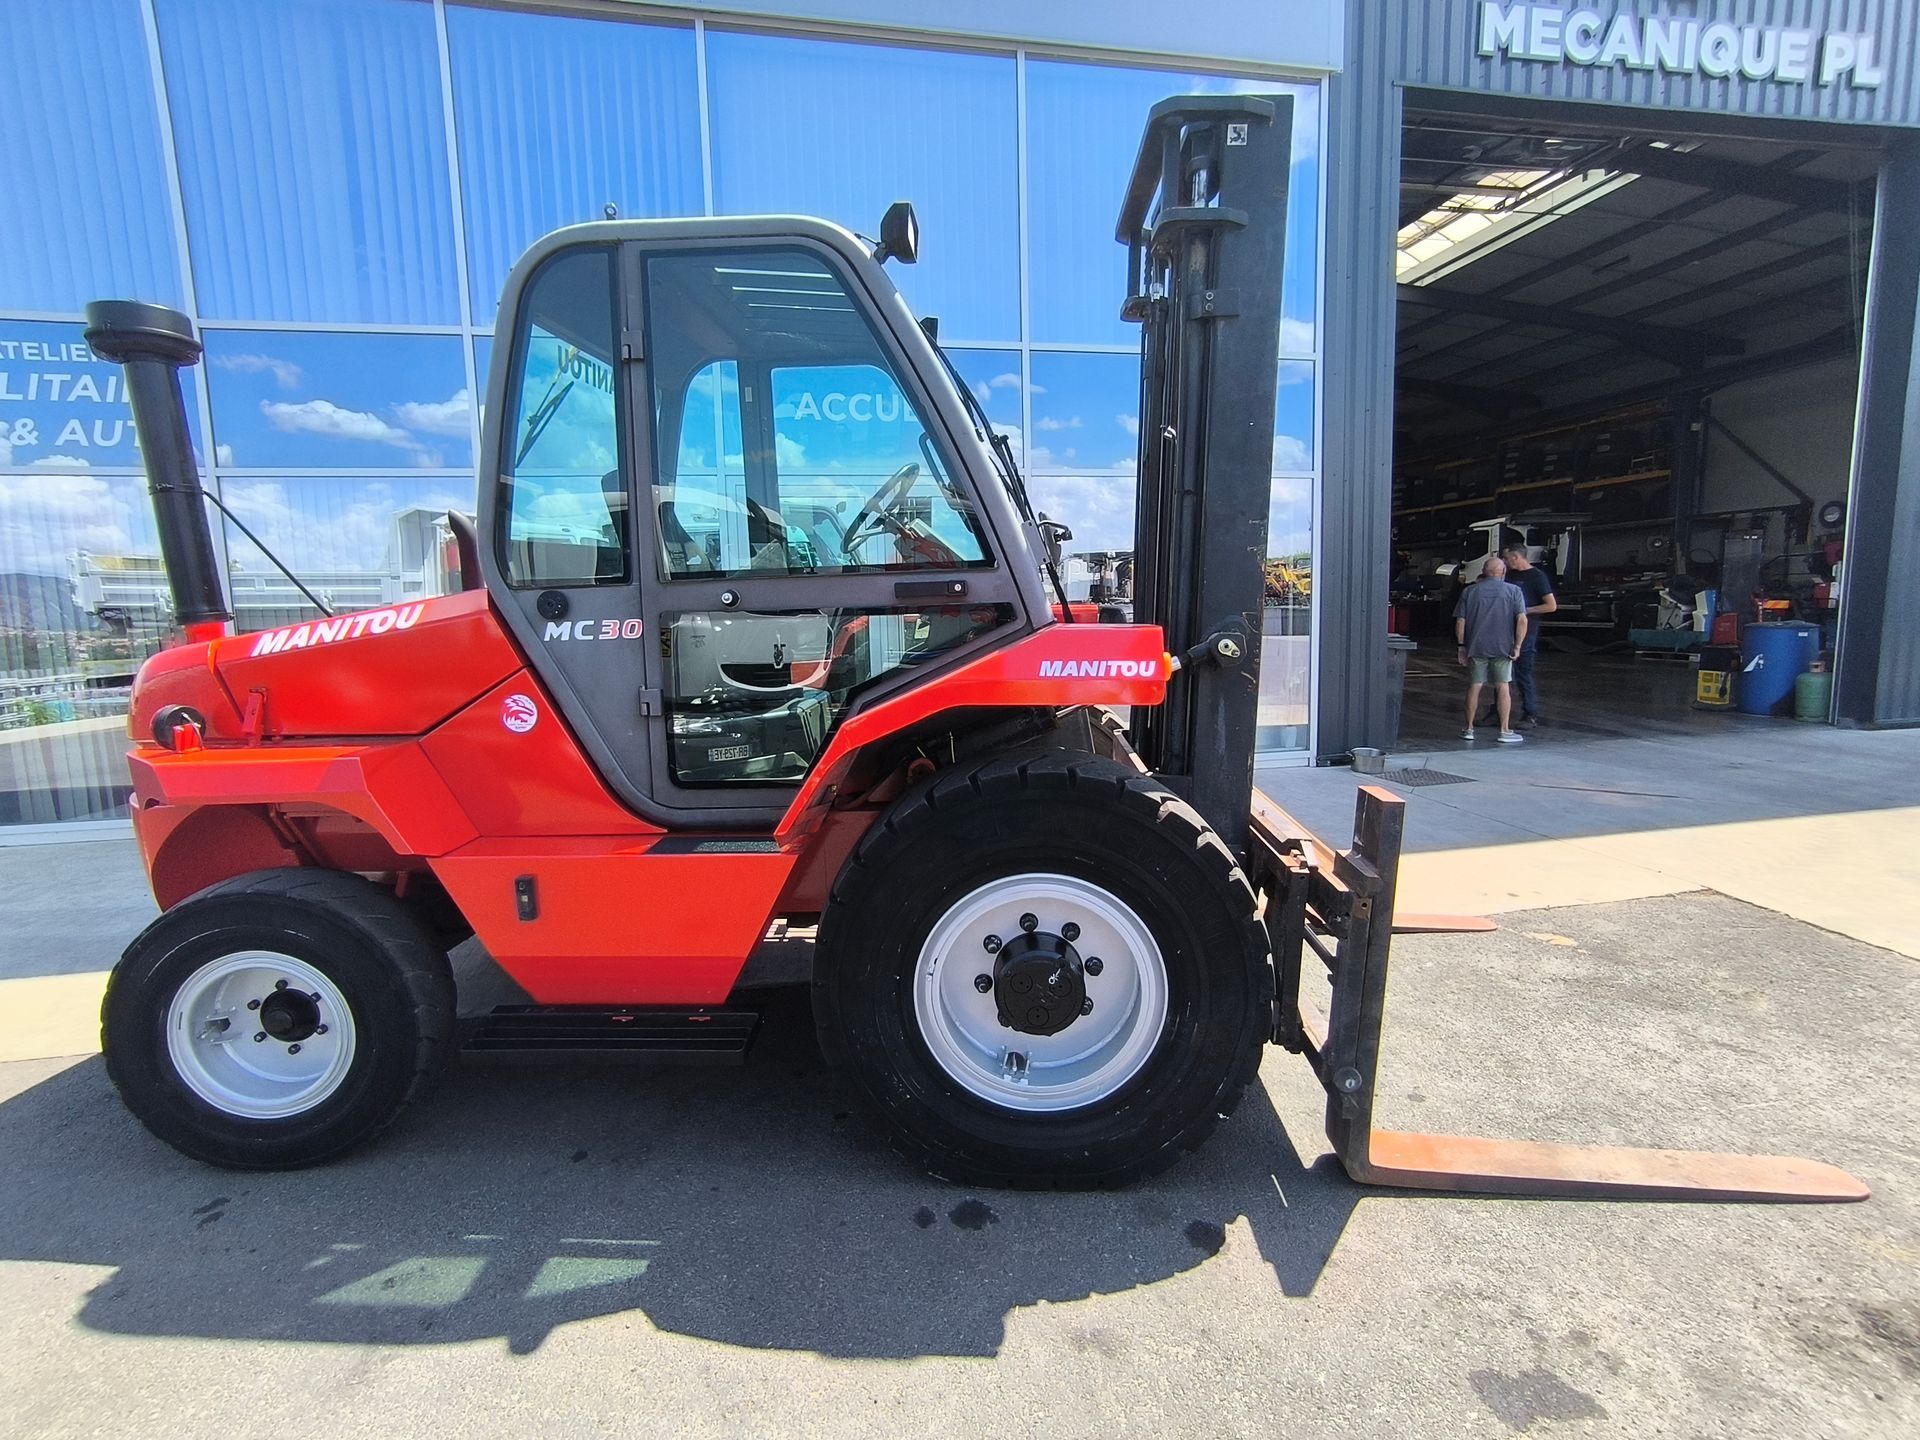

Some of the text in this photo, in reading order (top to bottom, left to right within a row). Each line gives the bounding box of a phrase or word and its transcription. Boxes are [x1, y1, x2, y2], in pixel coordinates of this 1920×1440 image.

[1480, 2, 1881, 88] MECANIQUE PL
[0, 340, 98, 362] TELIE
[9, 418, 39, 446] &
[250, 604, 424, 657] MANITOU
[1039, 660, 1156, 677] MANITOU
